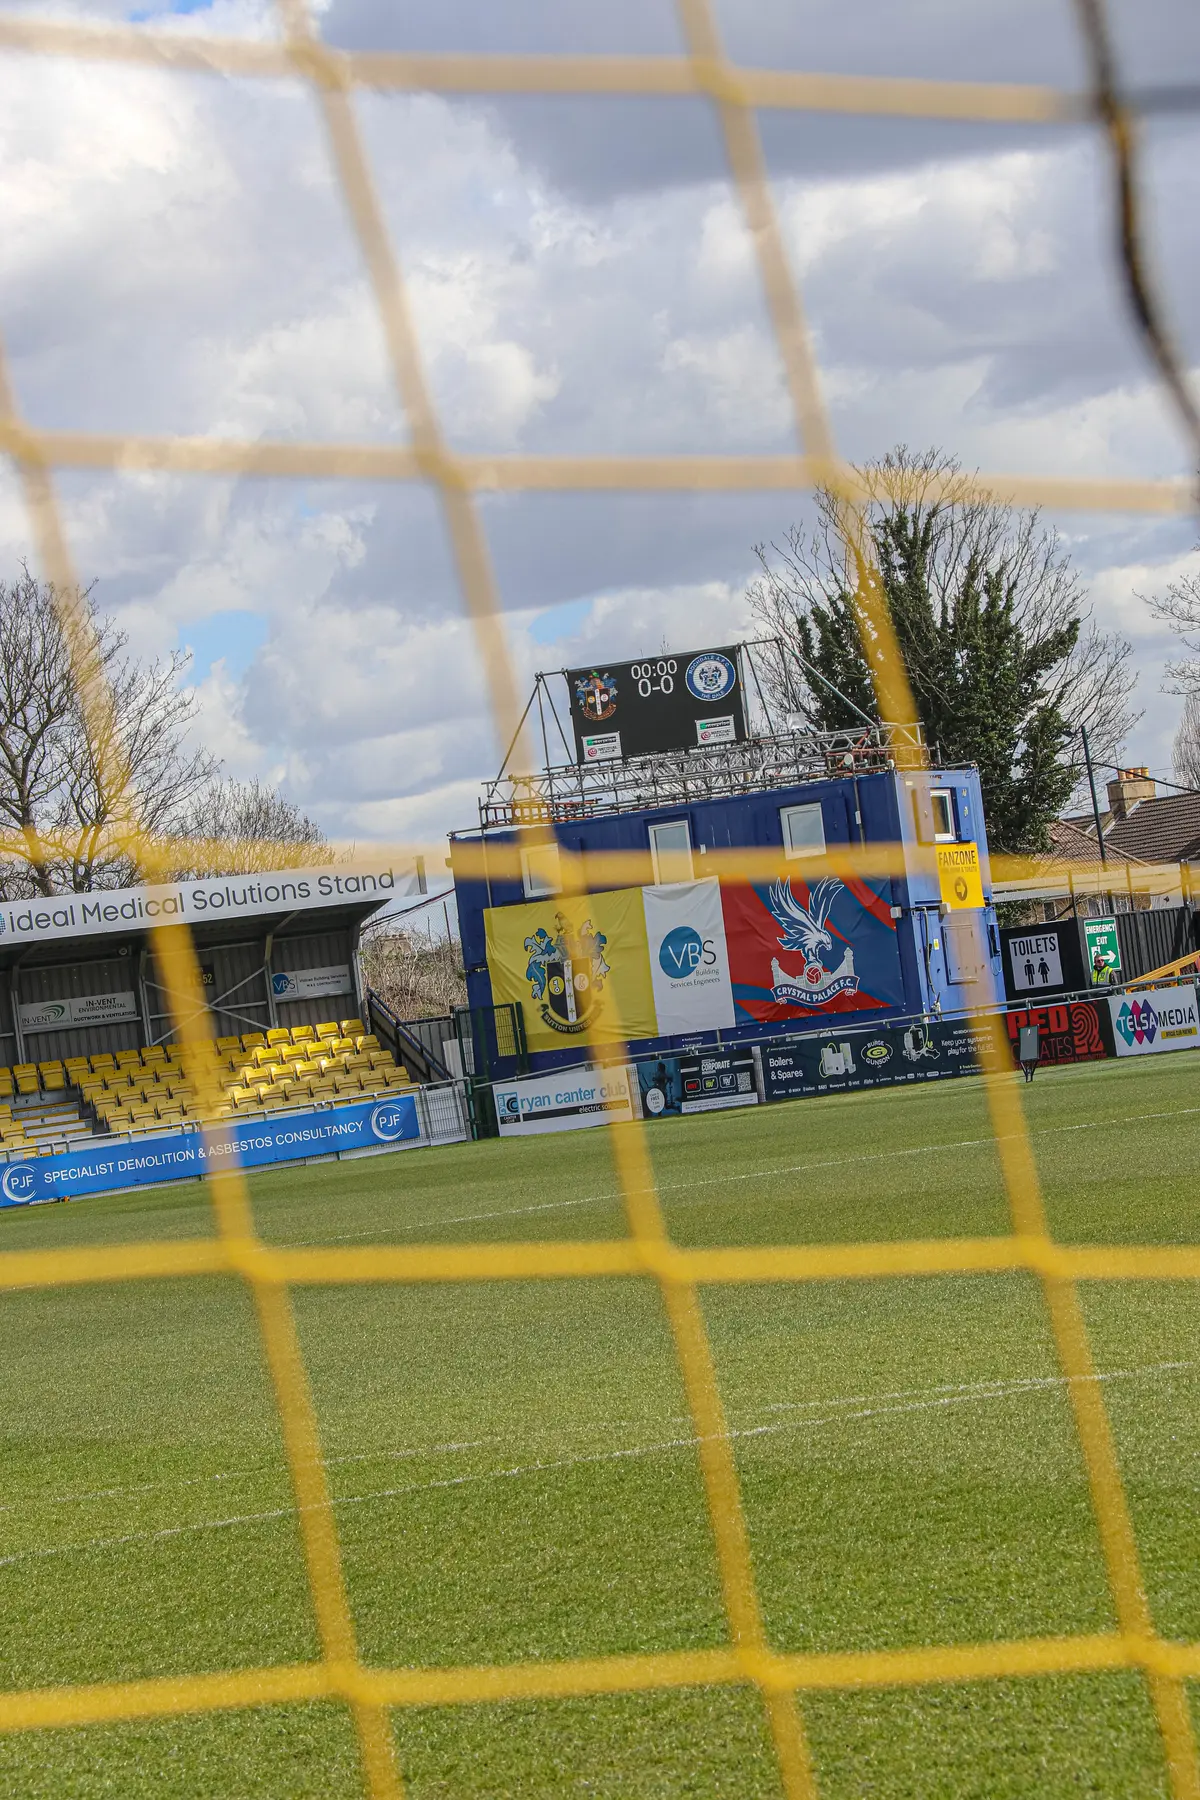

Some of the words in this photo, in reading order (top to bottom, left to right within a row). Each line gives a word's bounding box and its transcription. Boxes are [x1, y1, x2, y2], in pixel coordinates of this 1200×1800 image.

[631, 660, 678, 680] 00:00
[638, 675, 674, 697] 0-0
[938, 850, 977, 866] FANZONE
[9, 905, 76, 932] ideal
[82, 892, 185, 925] Medical
[193, 879, 311, 910] Solutions
[318, 868, 395, 896] Stand
[1086, 923, 1115, 934] EMERGENCY
[1011, 936, 1057, 957] TOILETS
[1096, 936, 1108, 945] EXIT
[668, 939, 716, 969] VBS
[273, 978, 296, 991] VBS
[670, 981, 693, 989] Services
[693, 978, 721, 987] Engineers
[776, 987, 811, 1001] CRYSTAL
[812, 982, 840, 1002] PALACE
[840, 978, 854, 988] F.C.
[78, 1003, 127, 1013] ENVIRONMENTAL
[85, 997, 117, 1007] IN-VENT
[21, 1015, 52, 1024] IN-VENT
[73, 1014, 101, 1022] DUCTWORK
[106, 1010, 136, 1019] VENTILATION
[543, 1013, 568, 1032] SUTTON
[568, 1019, 592, 1033] UNITED
[941, 1039, 954, 1047] Keep
[954, 1038, 966, 1046] your
[947, 1048, 960, 1056] play
[701, 1060, 731, 1072] CORPORATE
[769, 1057, 794, 1067] Boilers
[865, 1055, 891, 1066] GUNSON
[770, 1071, 778, 1080] &
[777, 1069, 804, 1081] Spares
[520, 1095, 551, 1113] ryan
[555, 1087, 596, 1105] canter
[599, 1080, 627, 1098] club
[579, 1104, 601, 1114] electric
[378, 1113, 401, 1129] PJF
[44, 1161, 115, 1183] SPECIALIST
[118, 1150, 195, 1172] DEMOLITION
[198, 1146, 207, 1159] &
[208, 1136, 273, 1157] ASBESTOS
[275, 1120, 364, 1146] CONSULTANCY
[10, 1174, 34, 1190] PJF
